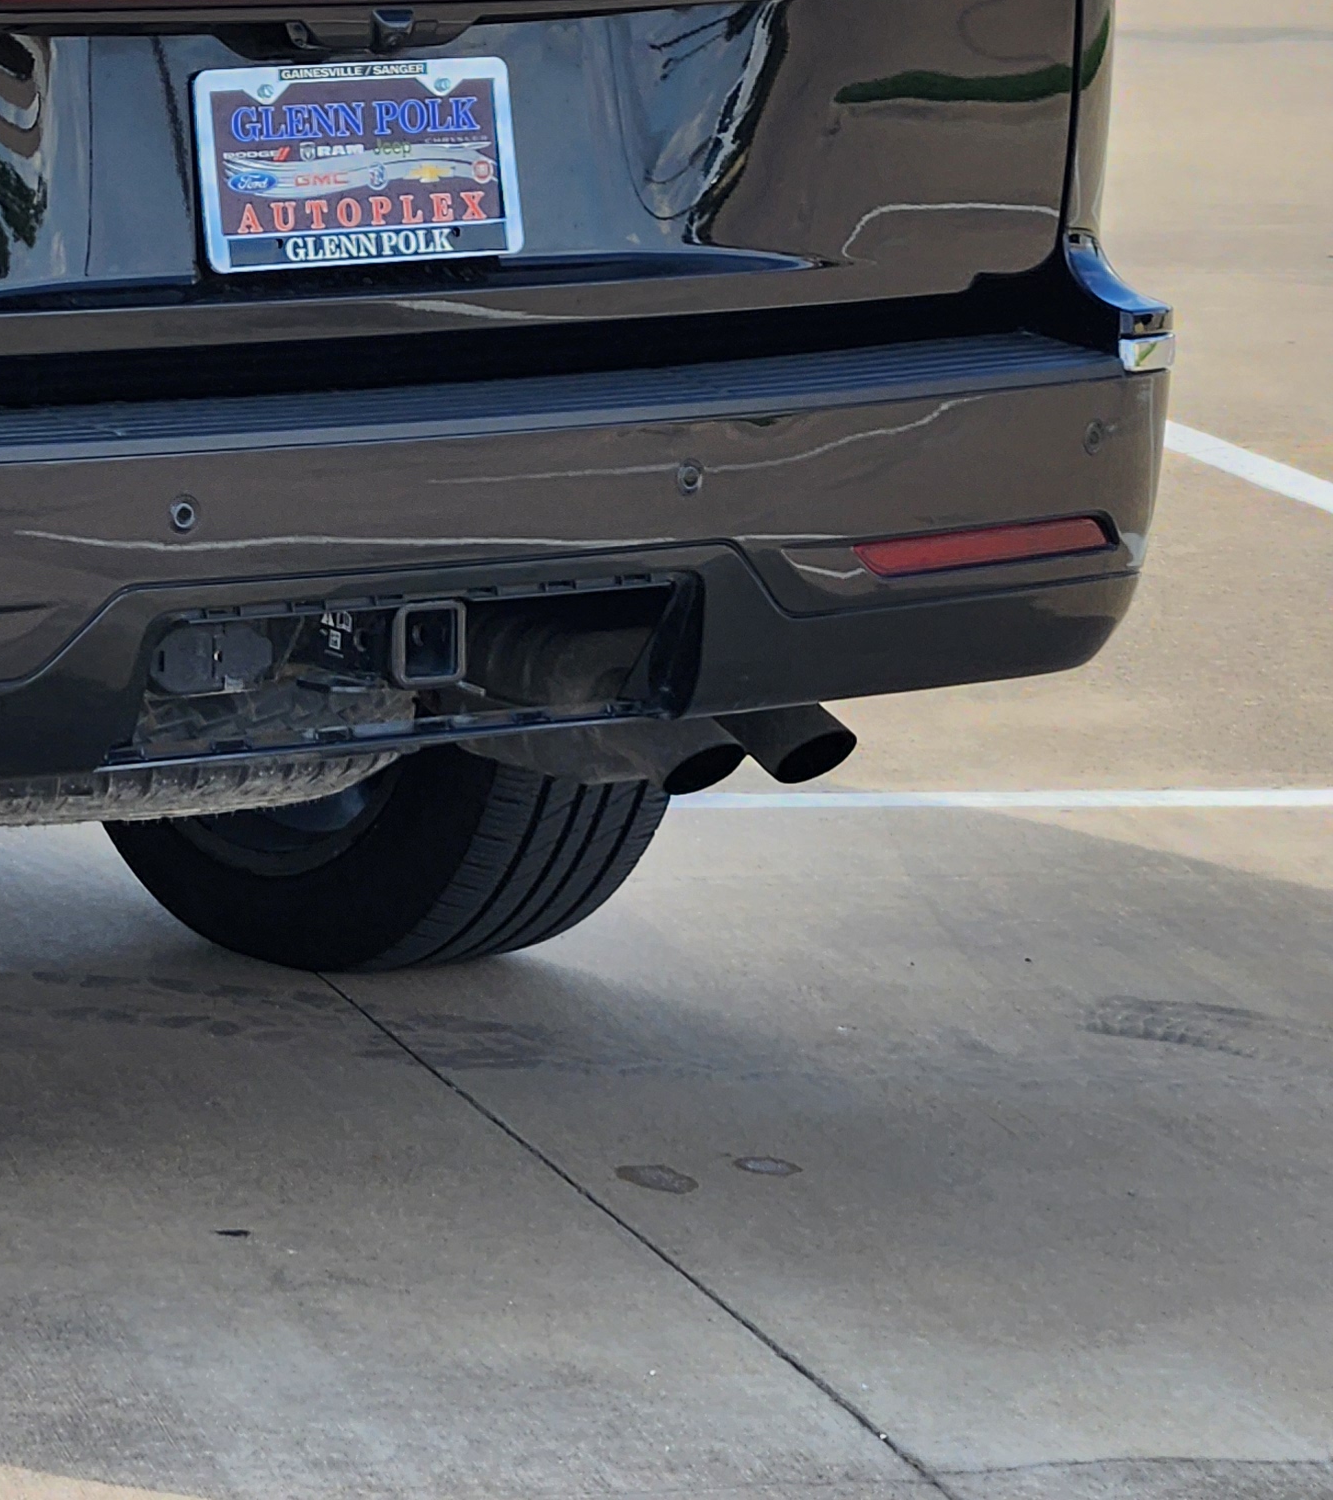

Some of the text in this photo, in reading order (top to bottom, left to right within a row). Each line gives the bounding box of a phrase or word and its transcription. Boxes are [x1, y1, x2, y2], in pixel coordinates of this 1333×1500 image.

[281, 65, 363, 81] GAINESVILLE
[372, 63, 425, 76] SANGER
[231, 96, 481, 142] GLENN POLK
[222, 149, 276, 160] DODGE
[317, 143, 365, 156] RAM
[237, 173, 269, 190] Ford
[293, 171, 349, 188] GMC
[236, 190, 488, 233] AUTOPLEX
[284, 226, 455, 262] GLENN POLK
